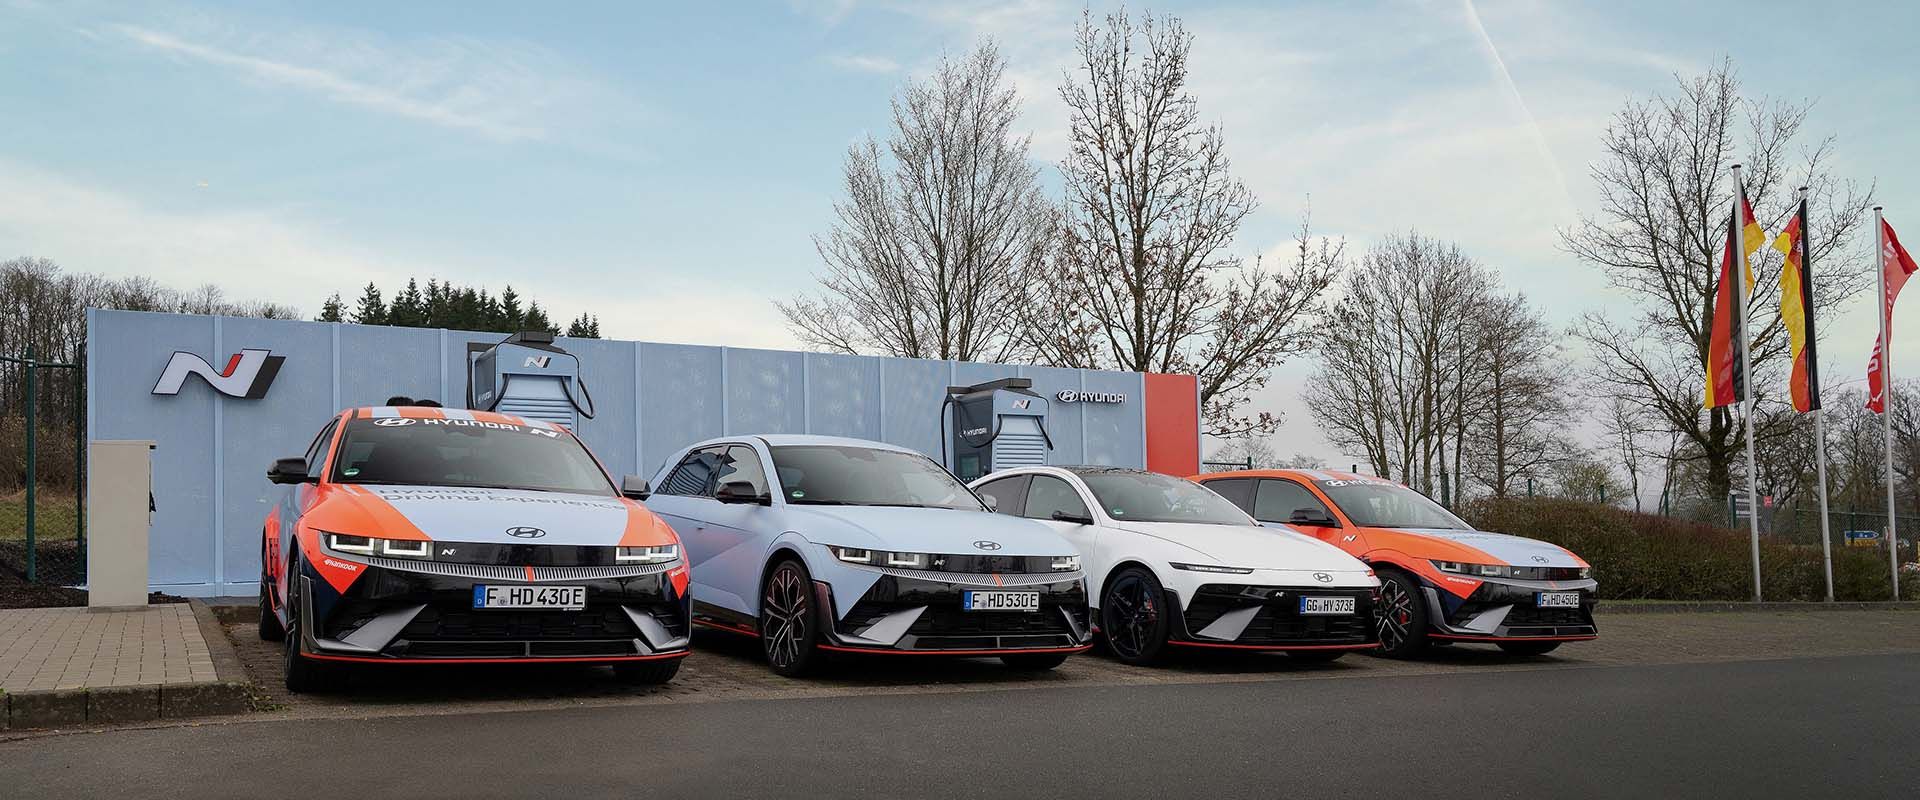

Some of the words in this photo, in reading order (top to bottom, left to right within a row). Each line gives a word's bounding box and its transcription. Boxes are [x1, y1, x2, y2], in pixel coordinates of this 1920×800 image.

[1080, 392, 1127, 404] HYUNDAI
[423, 418, 519, 432] HYUNDAI
[383, 494, 481, 502] Driving
[486, 495, 626, 511] Experience
[486, 588, 499, 606] F
[972, 593, 981, 608] F
[1541, 594, 1548, 605] F
[1306, 599, 1318, 612] GG
